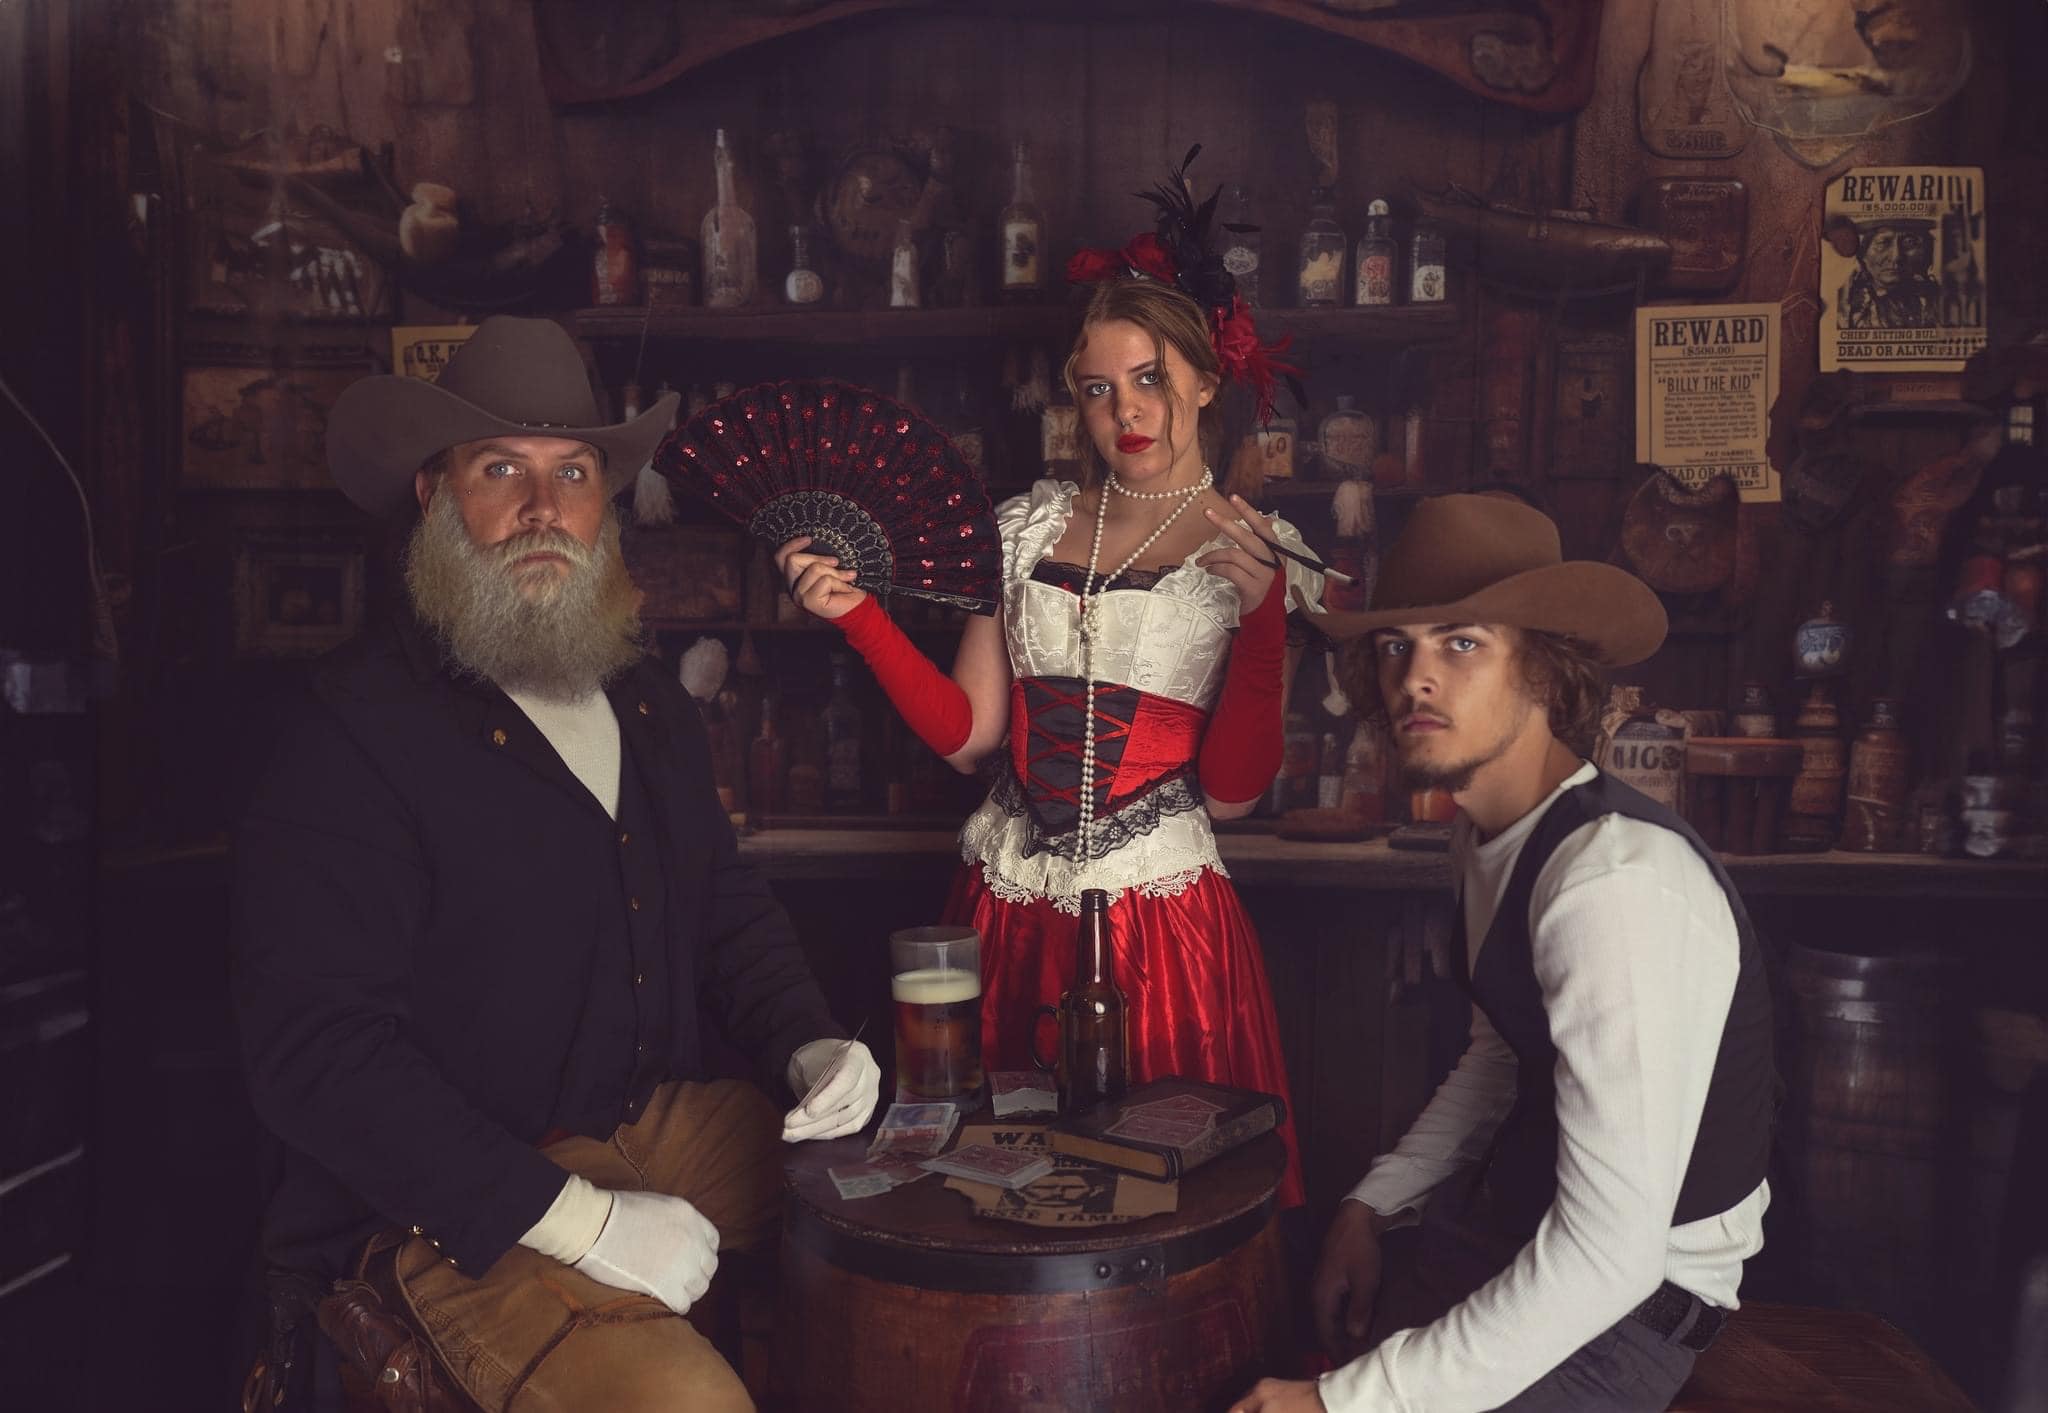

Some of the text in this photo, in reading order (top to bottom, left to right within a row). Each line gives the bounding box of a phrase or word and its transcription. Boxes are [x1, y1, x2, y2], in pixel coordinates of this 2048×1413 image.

[1654, 318, 1765, 346] REWARD
[1840, 331, 1869, 340] CHIEF
[1872, 331, 1912, 339] SITTING
[1838, 345, 1935, 357] DEAD OR ALIVE
[1703, 376, 1727, 391] THE
